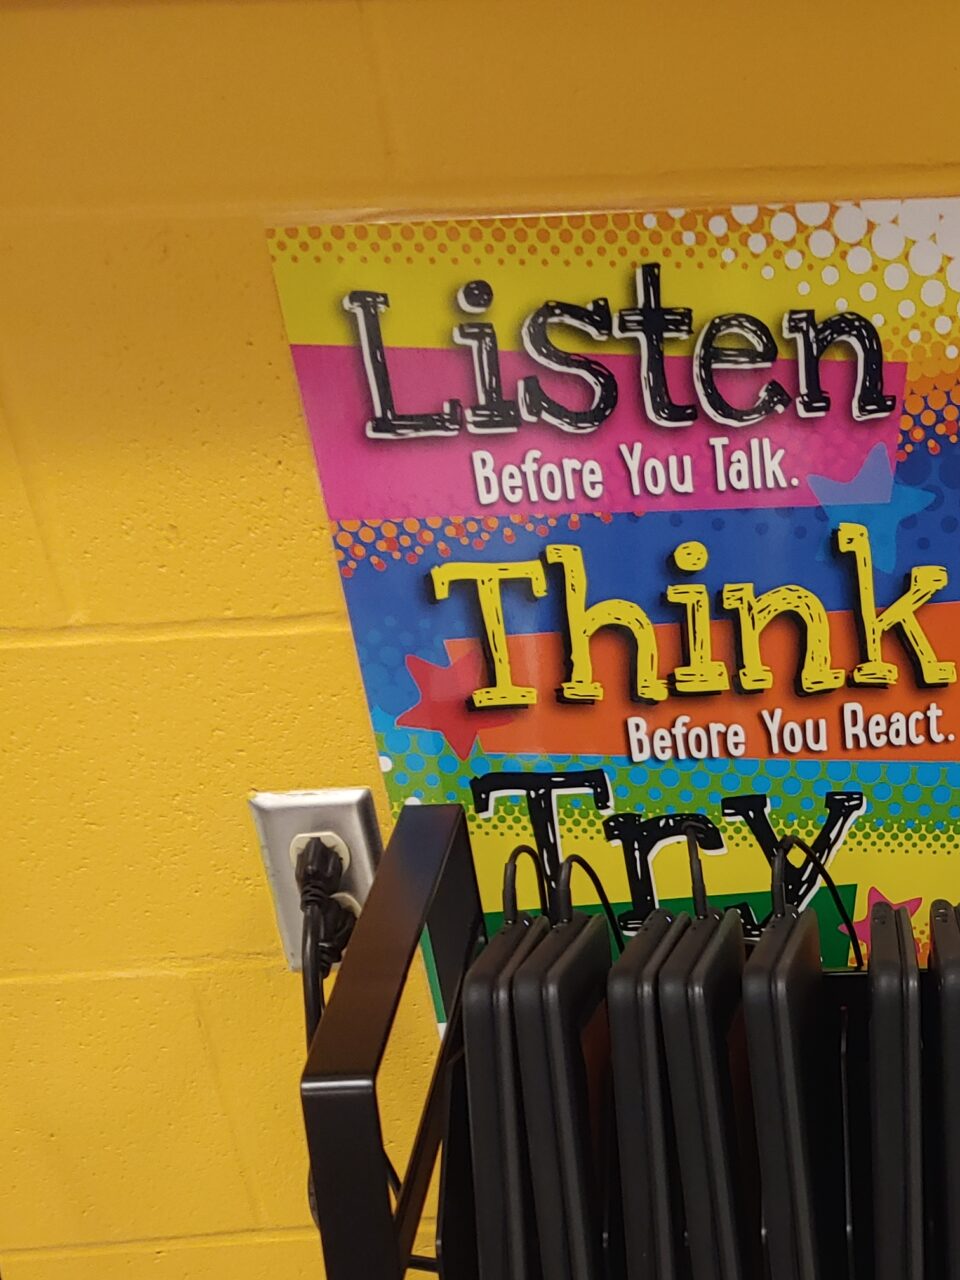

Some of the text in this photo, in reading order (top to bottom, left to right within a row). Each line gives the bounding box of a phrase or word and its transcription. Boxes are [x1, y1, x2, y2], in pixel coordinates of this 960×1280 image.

[342, 262, 898, 439] Listen
[472, 435, 800, 505] Before You Talk.
[430, 522, 958, 707] Think
[627, 700, 956, 763] Before You React.
[470, 769, 867, 940] Try
